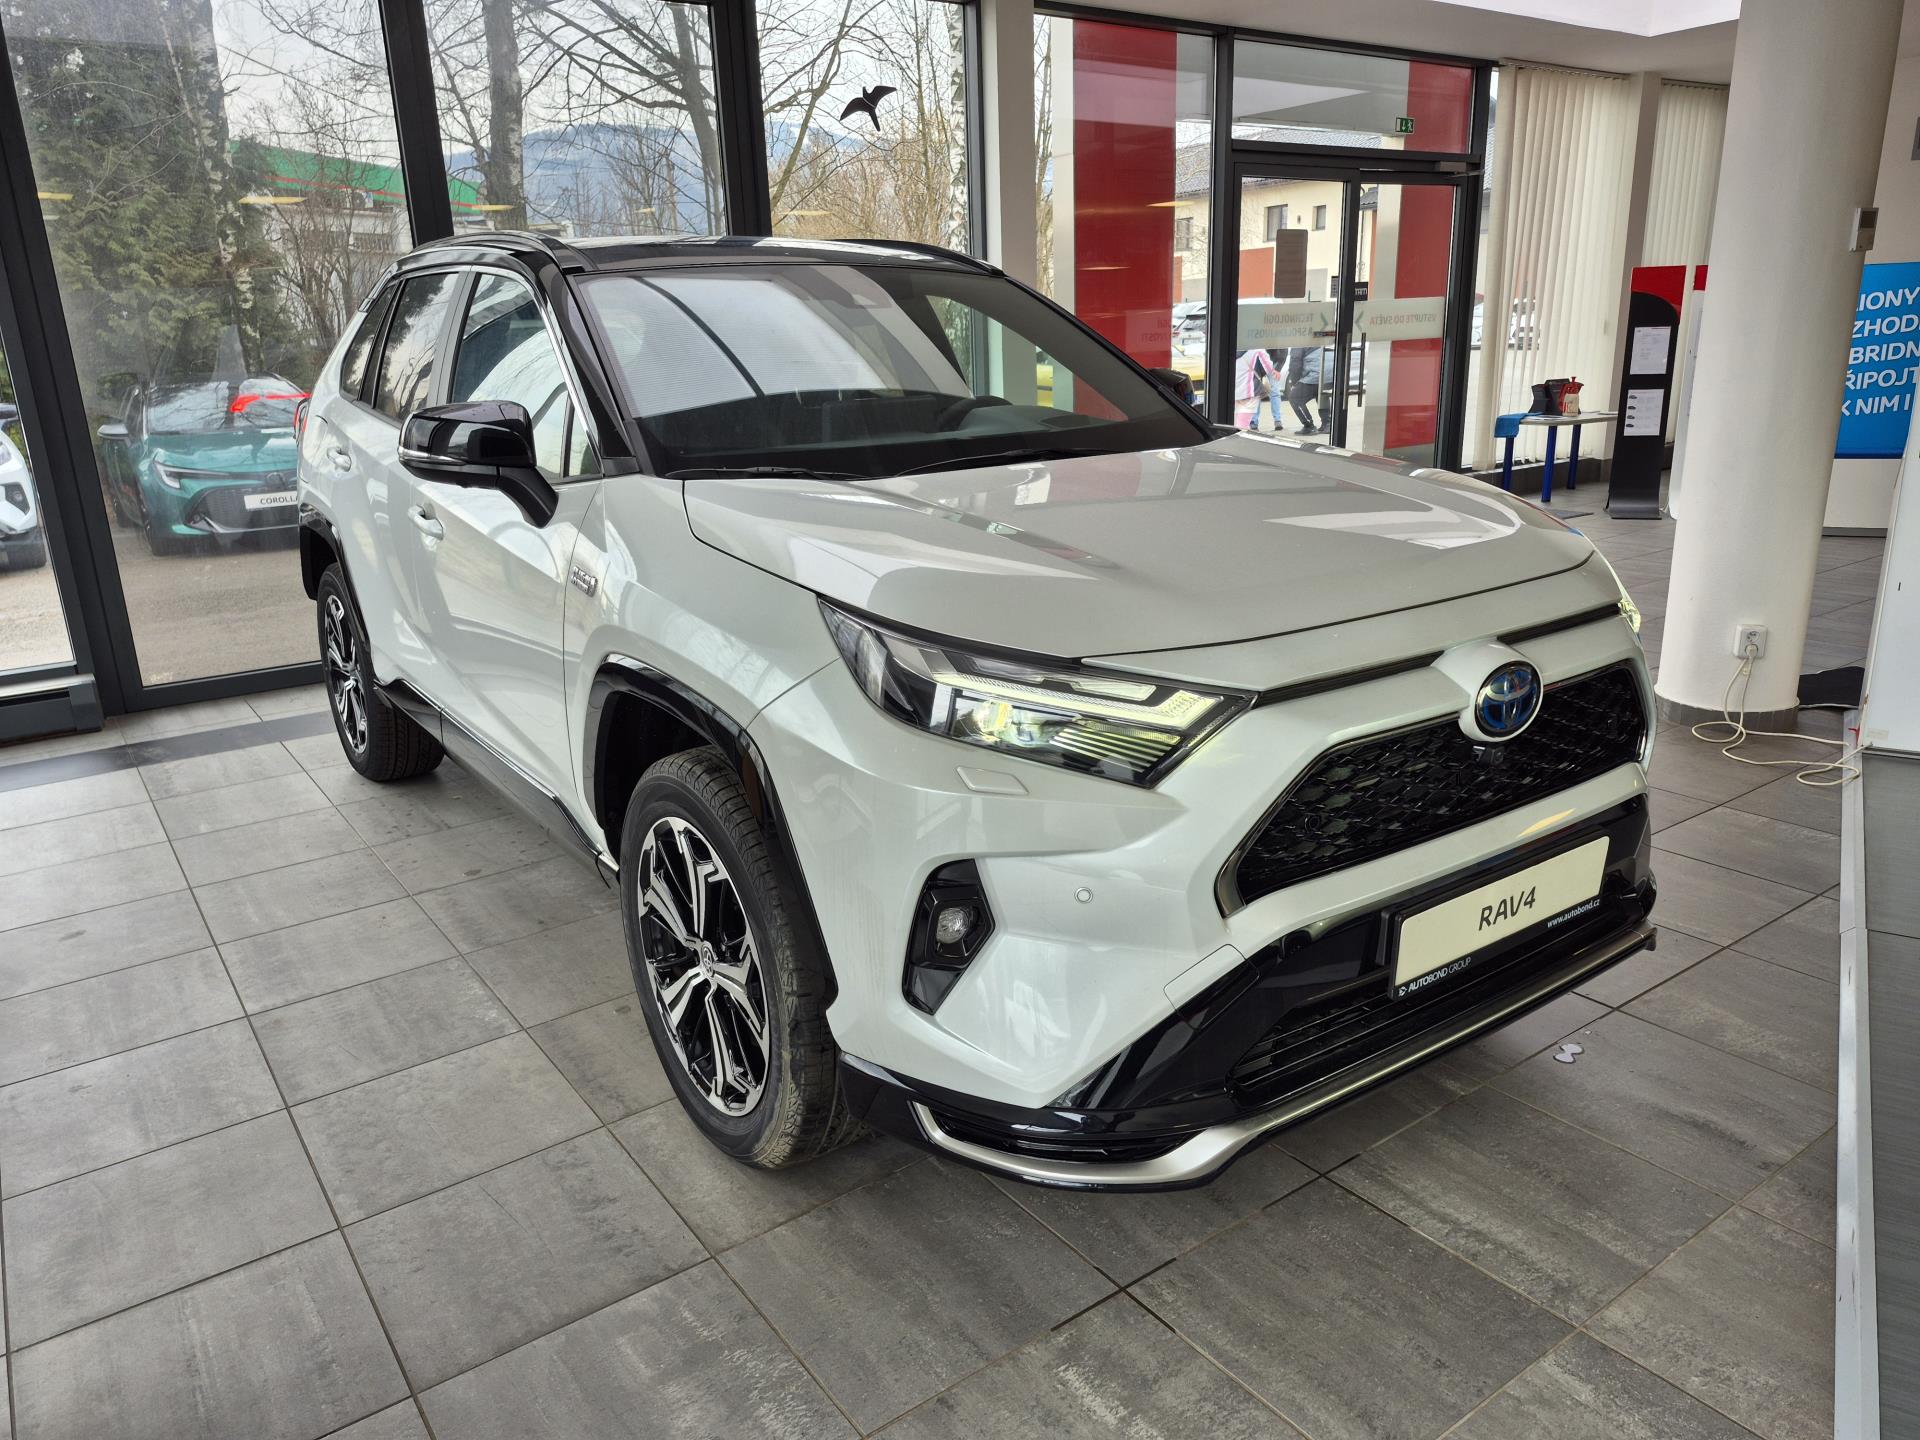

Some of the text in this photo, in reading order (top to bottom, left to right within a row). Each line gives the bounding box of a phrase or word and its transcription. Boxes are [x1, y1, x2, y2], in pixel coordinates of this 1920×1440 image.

[1856, 286, 1920, 311] IONY
[1855, 394, 1900, 416] NIM
[1478, 885, 1536, 931] RAV4
[1547, 898, 1600, 928] www.autobond.cz
[1408, 956, 1472, 993] AUTOBOND GROUP
